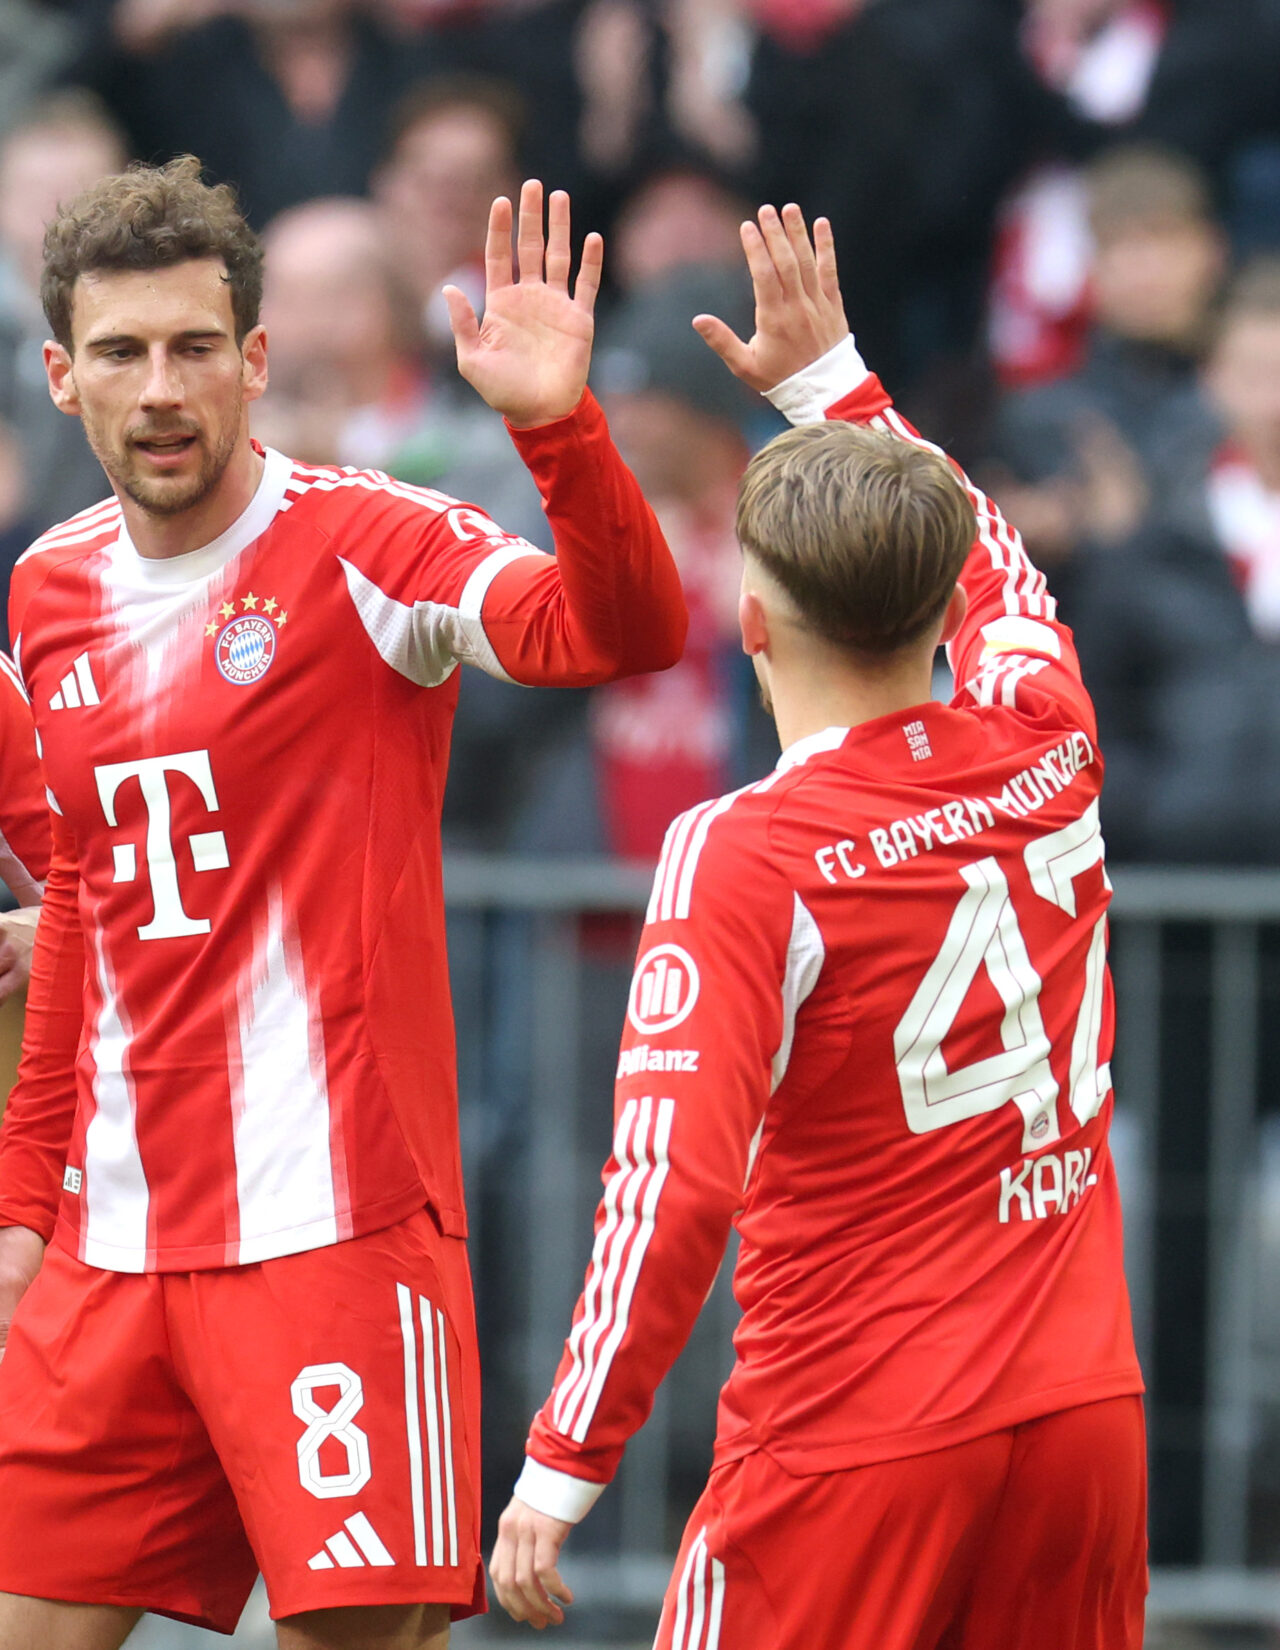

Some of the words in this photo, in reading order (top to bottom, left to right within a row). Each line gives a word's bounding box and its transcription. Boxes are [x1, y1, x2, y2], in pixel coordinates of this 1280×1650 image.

[221, 631, 235, 648] FC
[234, 620, 272, 643] BAYERN
[902, 720, 926, 738] MIA
[907, 732, 930, 750] SAN
[911, 745, 933, 762] MIA
[94, 749, 230, 941] T
[814, 839, 866, 884] FC
[868, 798, 995, 869] BAYERN
[616, 1043, 700, 1079] Allianz
[998, 1147, 1098, 1224] KARL
[290, 1361, 372, 1500] 8
